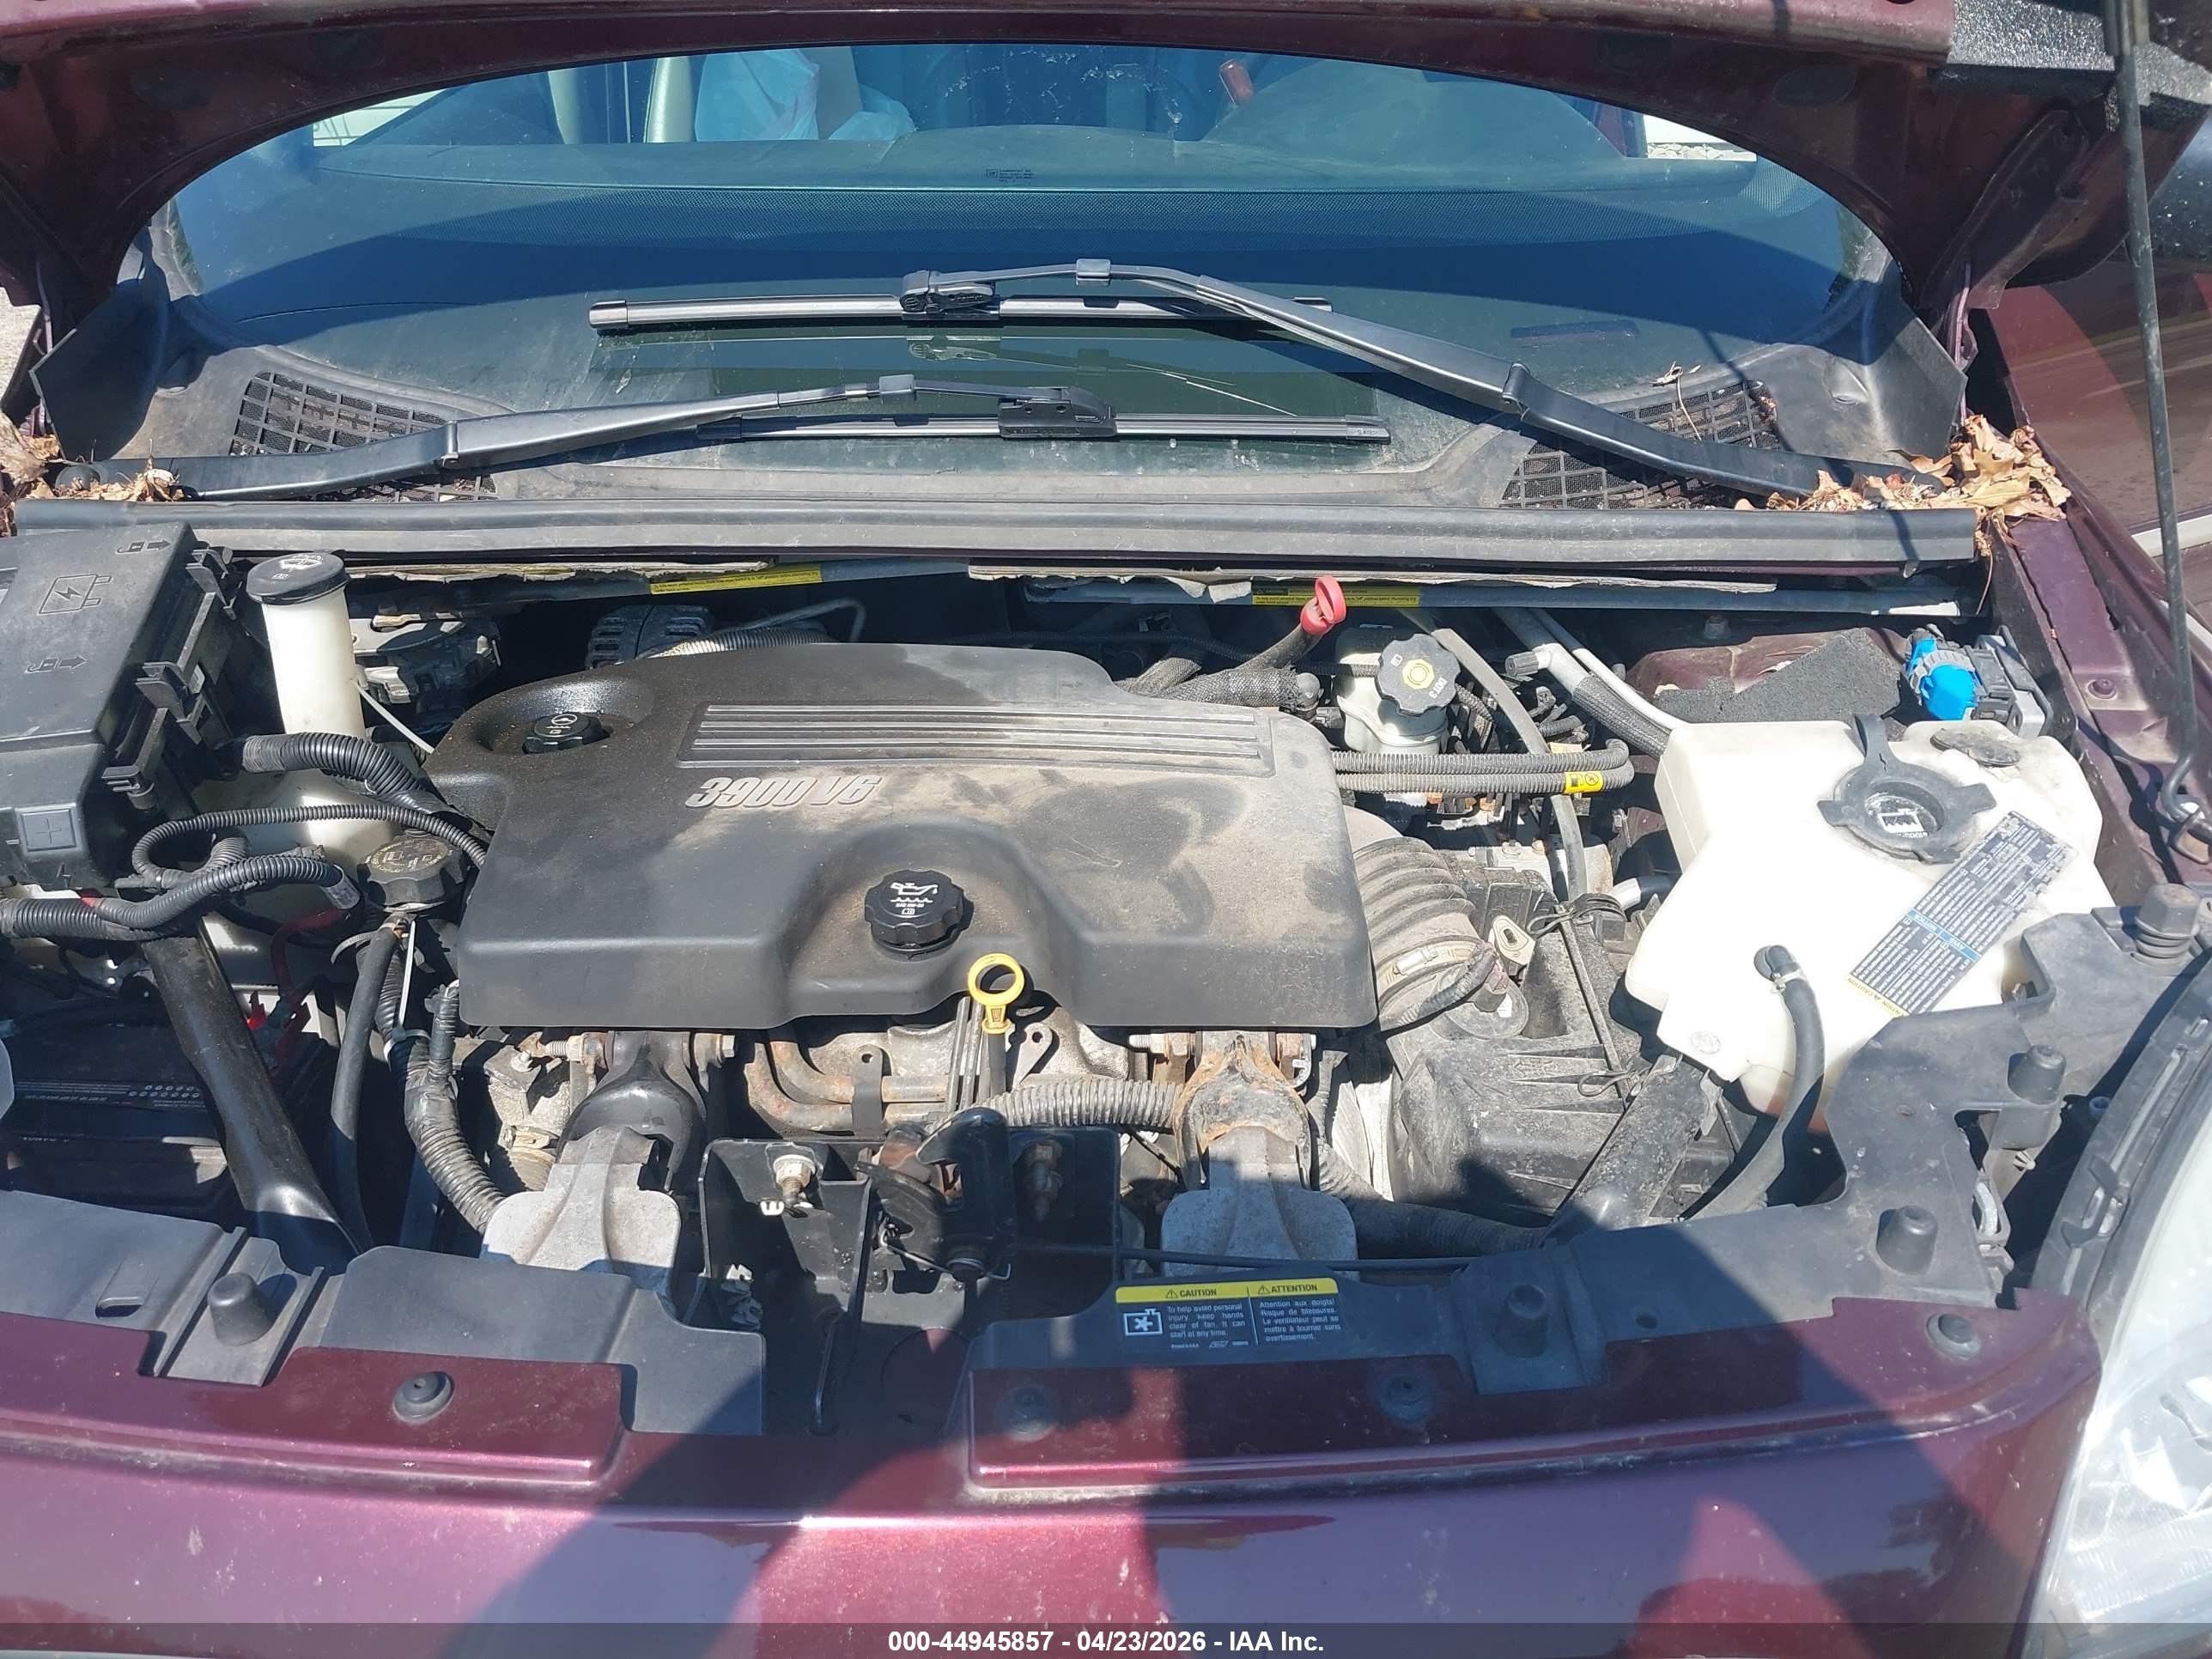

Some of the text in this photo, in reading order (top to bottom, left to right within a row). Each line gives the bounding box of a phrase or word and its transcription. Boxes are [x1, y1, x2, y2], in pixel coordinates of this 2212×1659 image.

[1433, 677, 1448, 695] DOT
[685, 775, 883, 808] 3900 V6
[1914, 914, 1937, 932] NOTICE
[1271, 1284, 1318, 1292] ATTENTION
[1213, 1303, 1243, 1312] personal
